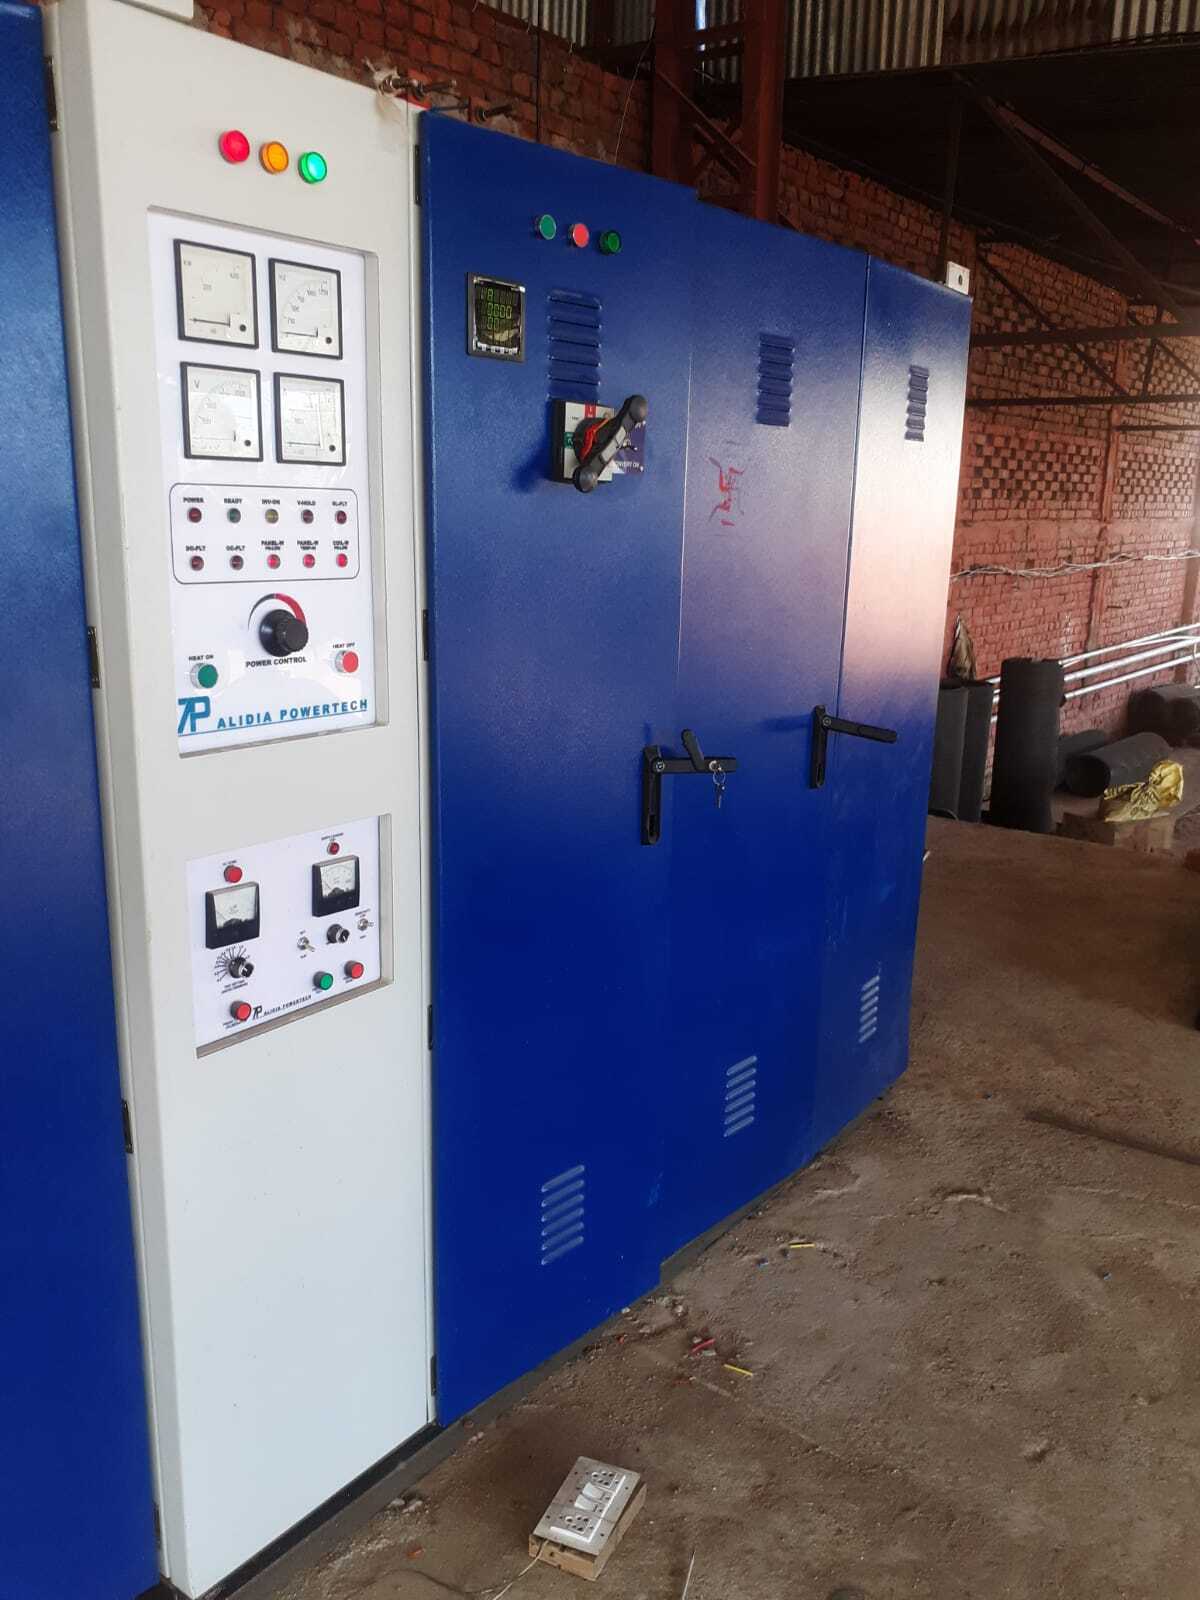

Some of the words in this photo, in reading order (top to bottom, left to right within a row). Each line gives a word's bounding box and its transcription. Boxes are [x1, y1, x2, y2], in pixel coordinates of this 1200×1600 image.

[245, 659, 272, 668] POWER
[273, 656, 307, 666] CONTROL
[217, 711, 273, 729] ALIDIA
[279, 699, 368, 720] POWERTECH
